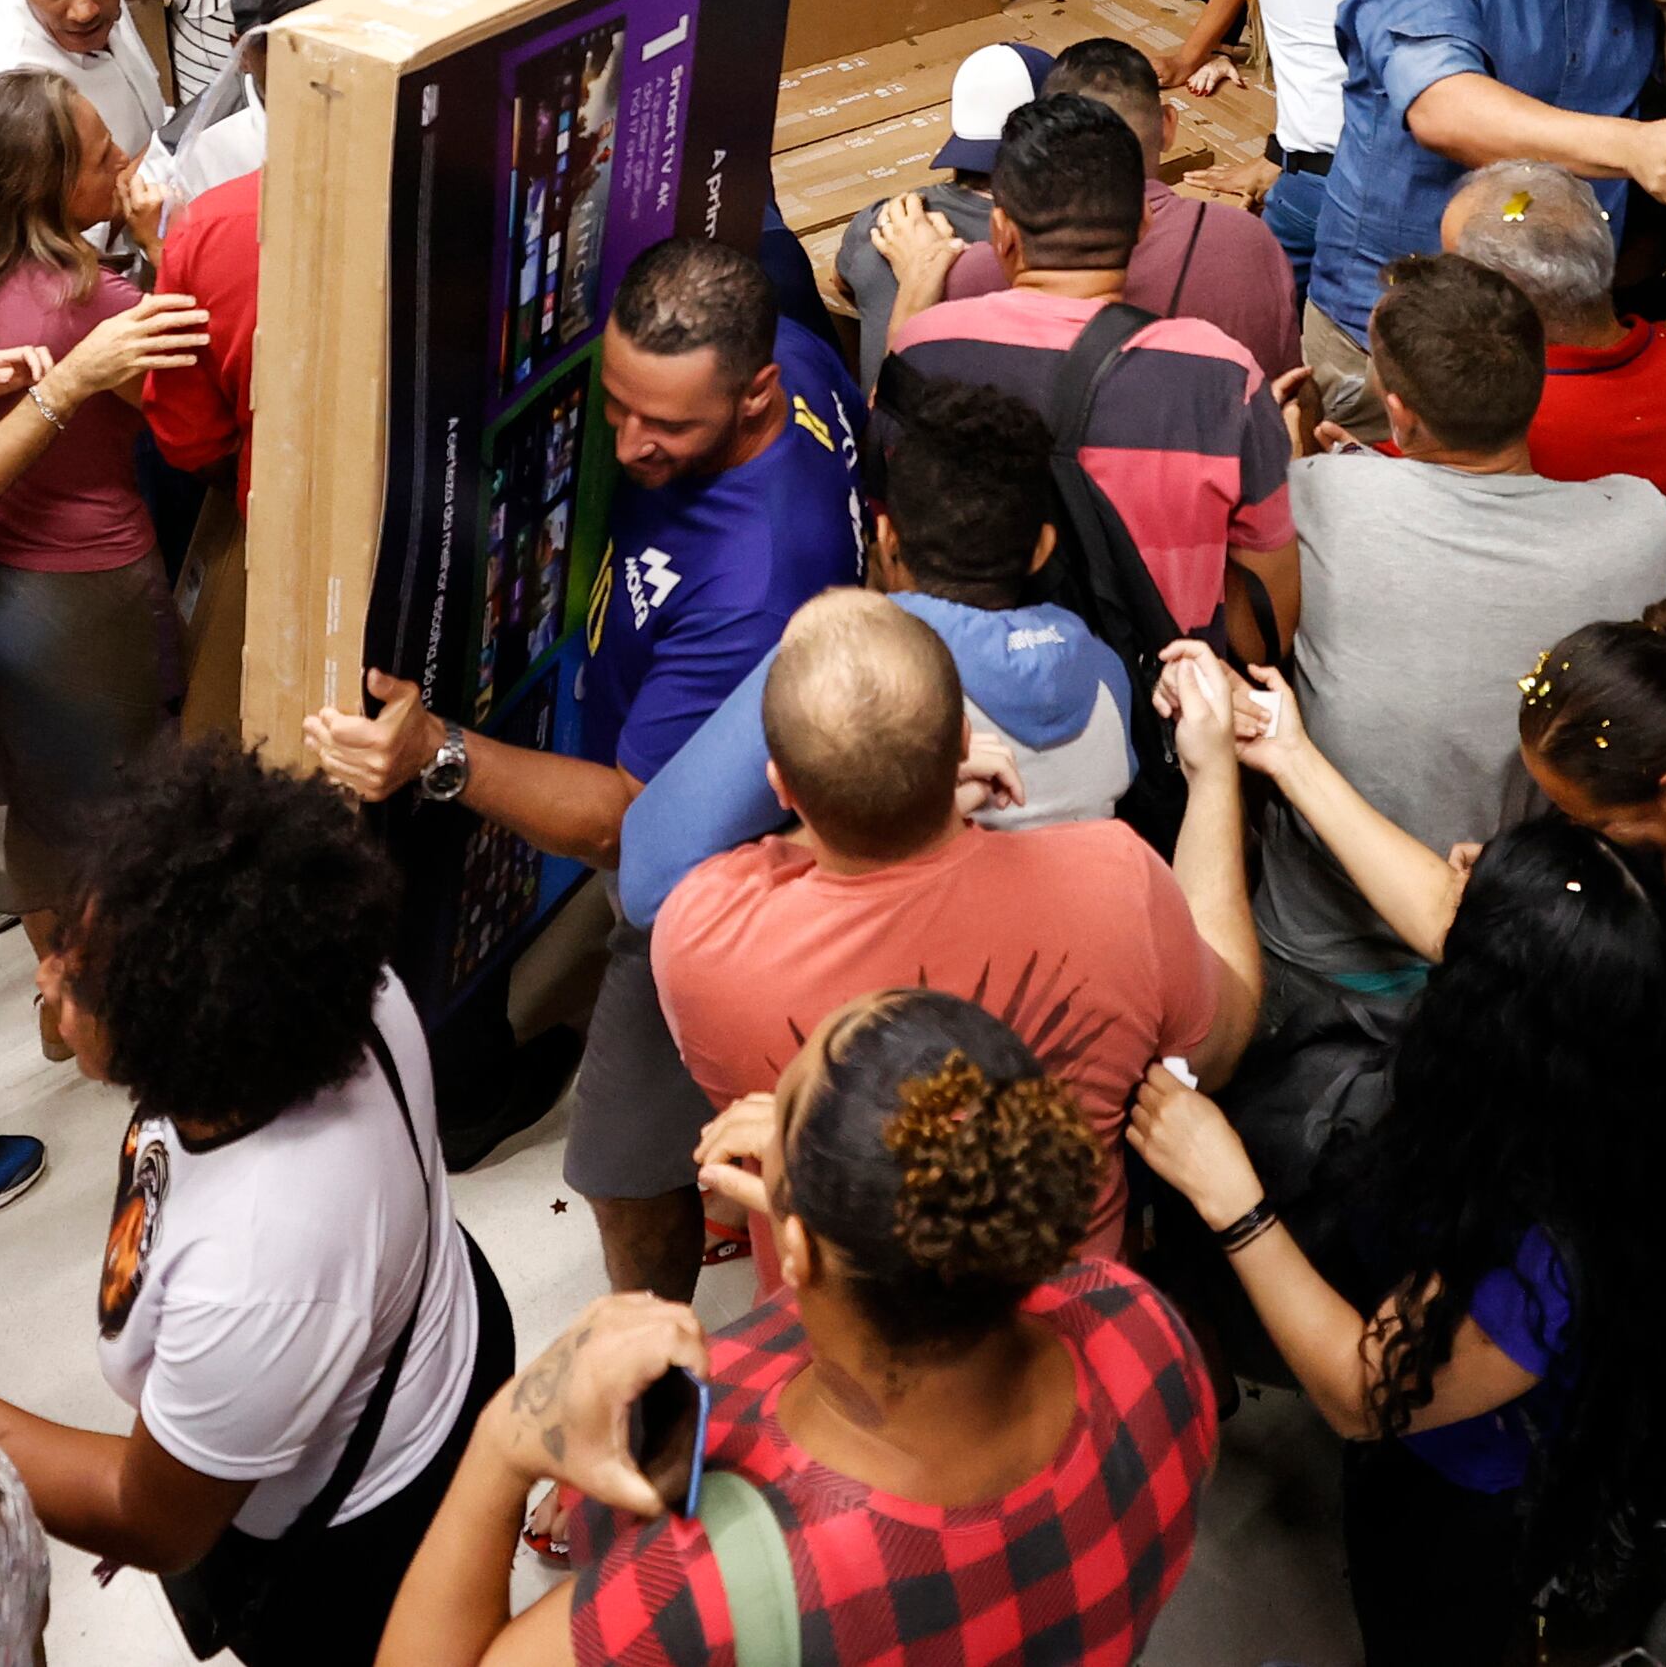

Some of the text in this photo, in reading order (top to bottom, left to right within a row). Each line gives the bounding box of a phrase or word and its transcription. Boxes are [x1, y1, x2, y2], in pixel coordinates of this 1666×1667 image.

[641, 14, 689, 62] 1
[661, 64, 683, 174] Smart TV
